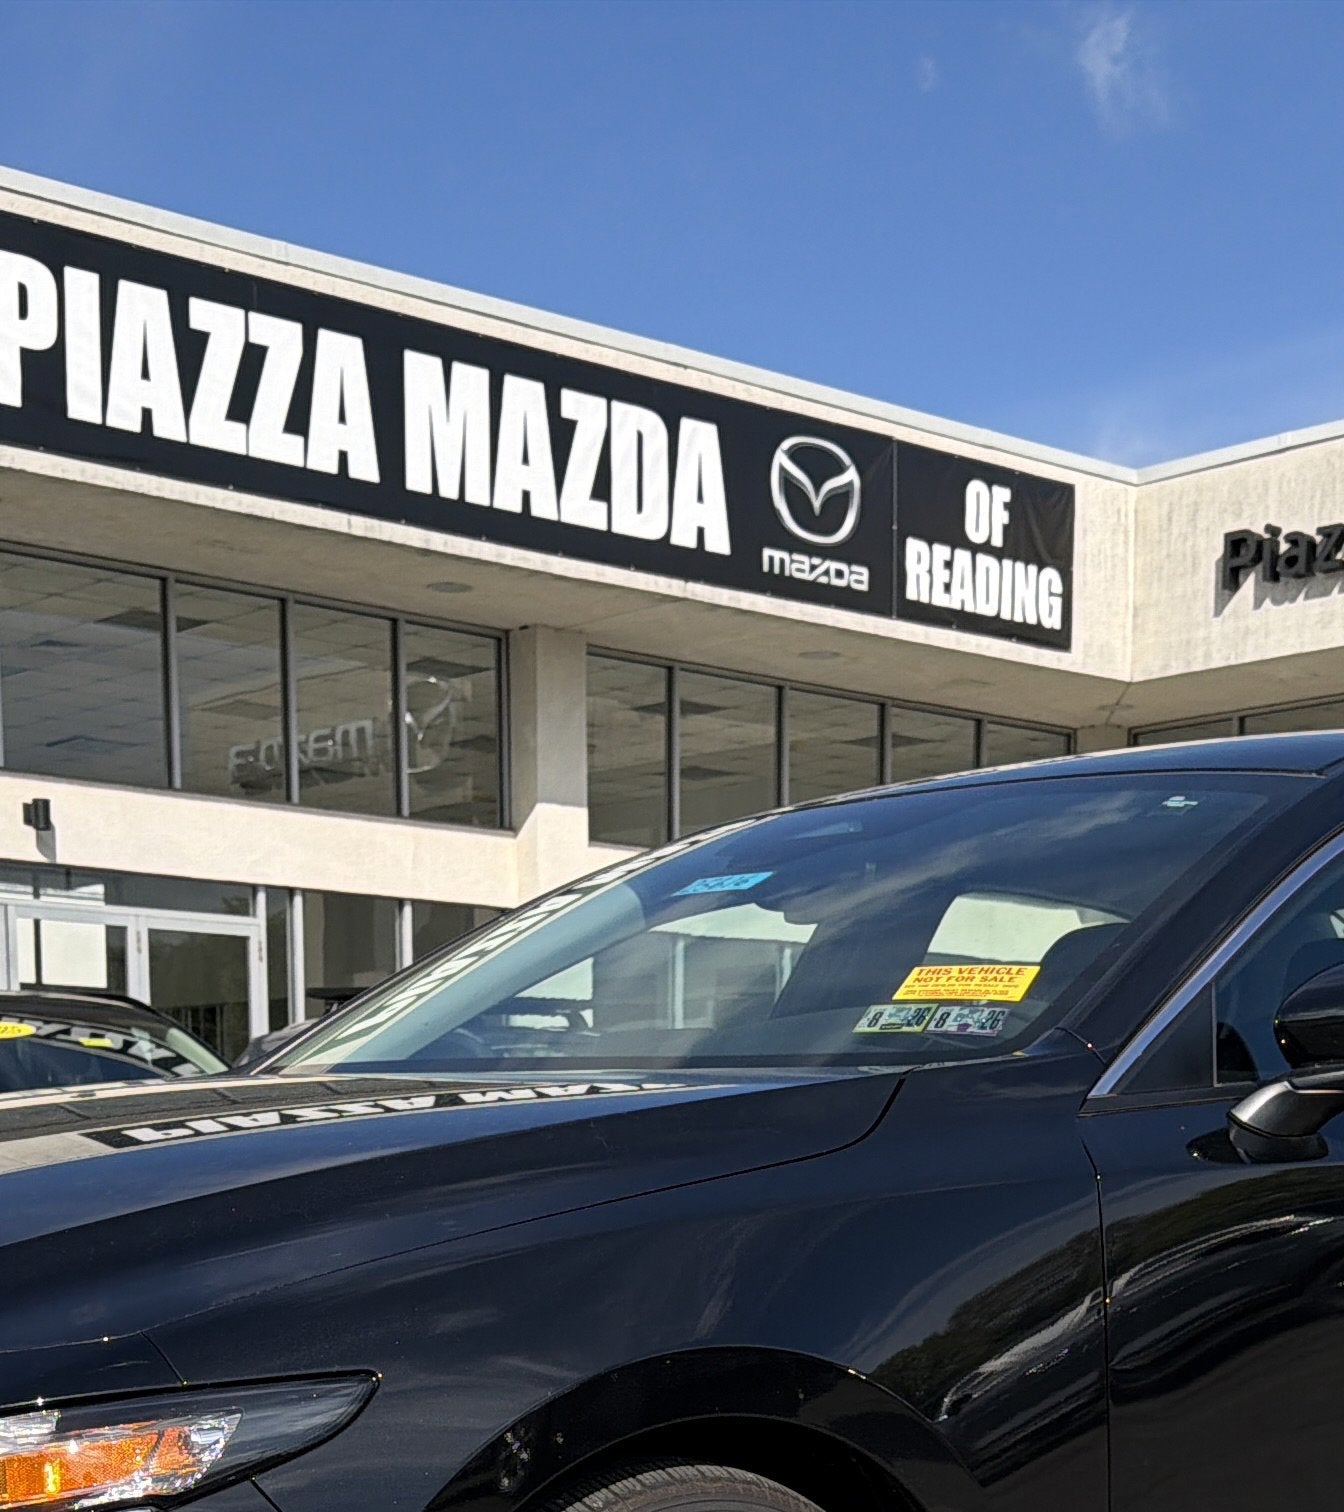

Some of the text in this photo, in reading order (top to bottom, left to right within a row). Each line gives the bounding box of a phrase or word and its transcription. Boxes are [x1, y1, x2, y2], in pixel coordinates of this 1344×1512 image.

[403, 349, 731, 556] MAZDA
[964, 478, 1012, 547] OF
[761, 546, 870, 592] mazda
[905, 537, 1064, 631] READING
[913, 975, 1019, 983] NOT FOR SALE
[917, 967, 1028, 976] THIS VEHICLE
